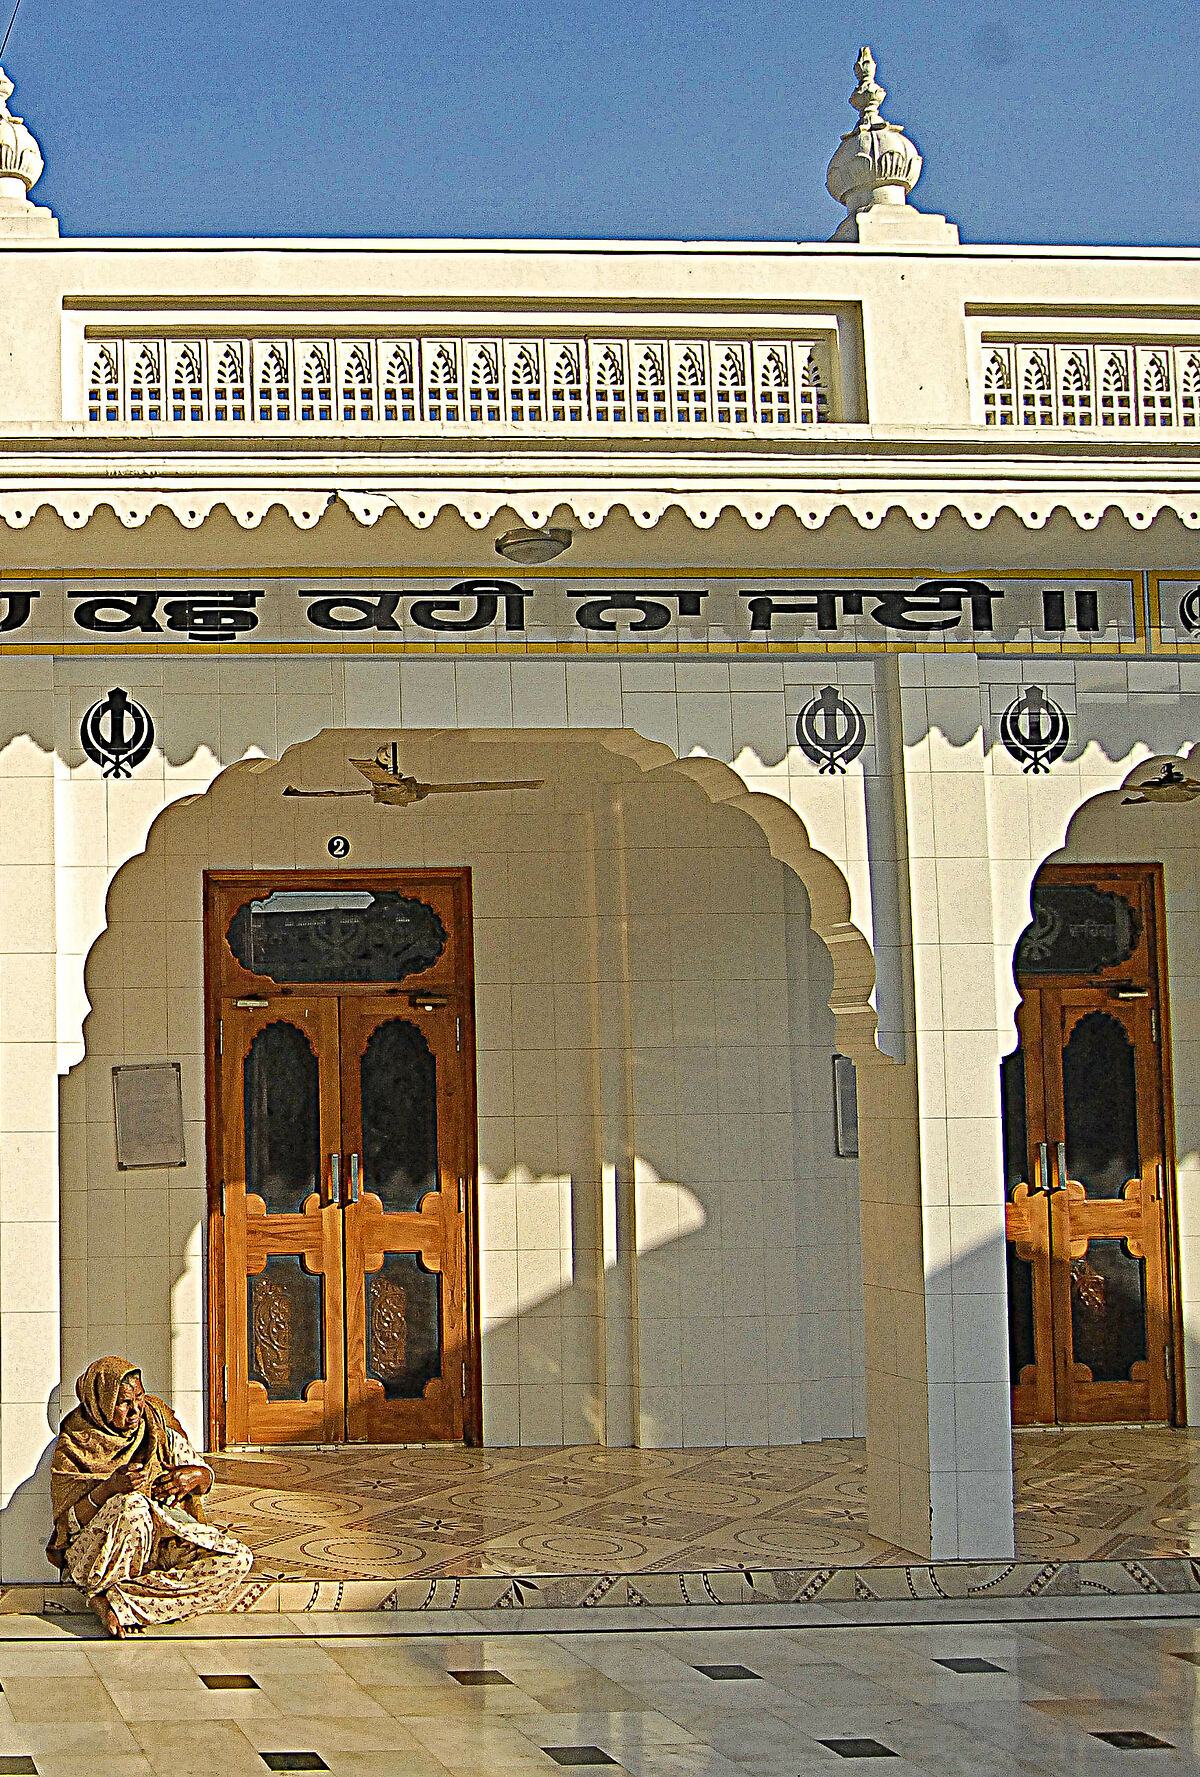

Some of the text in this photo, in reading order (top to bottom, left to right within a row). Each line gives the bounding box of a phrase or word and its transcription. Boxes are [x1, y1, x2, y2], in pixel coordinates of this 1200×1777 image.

[298, 580, 534, 632] ਕਹੀ
[566, 590, 709, 631] ਨਾ
[738, 580, 1004, 632] ਜਾਈ
[333, 838, 345, 855] 2
